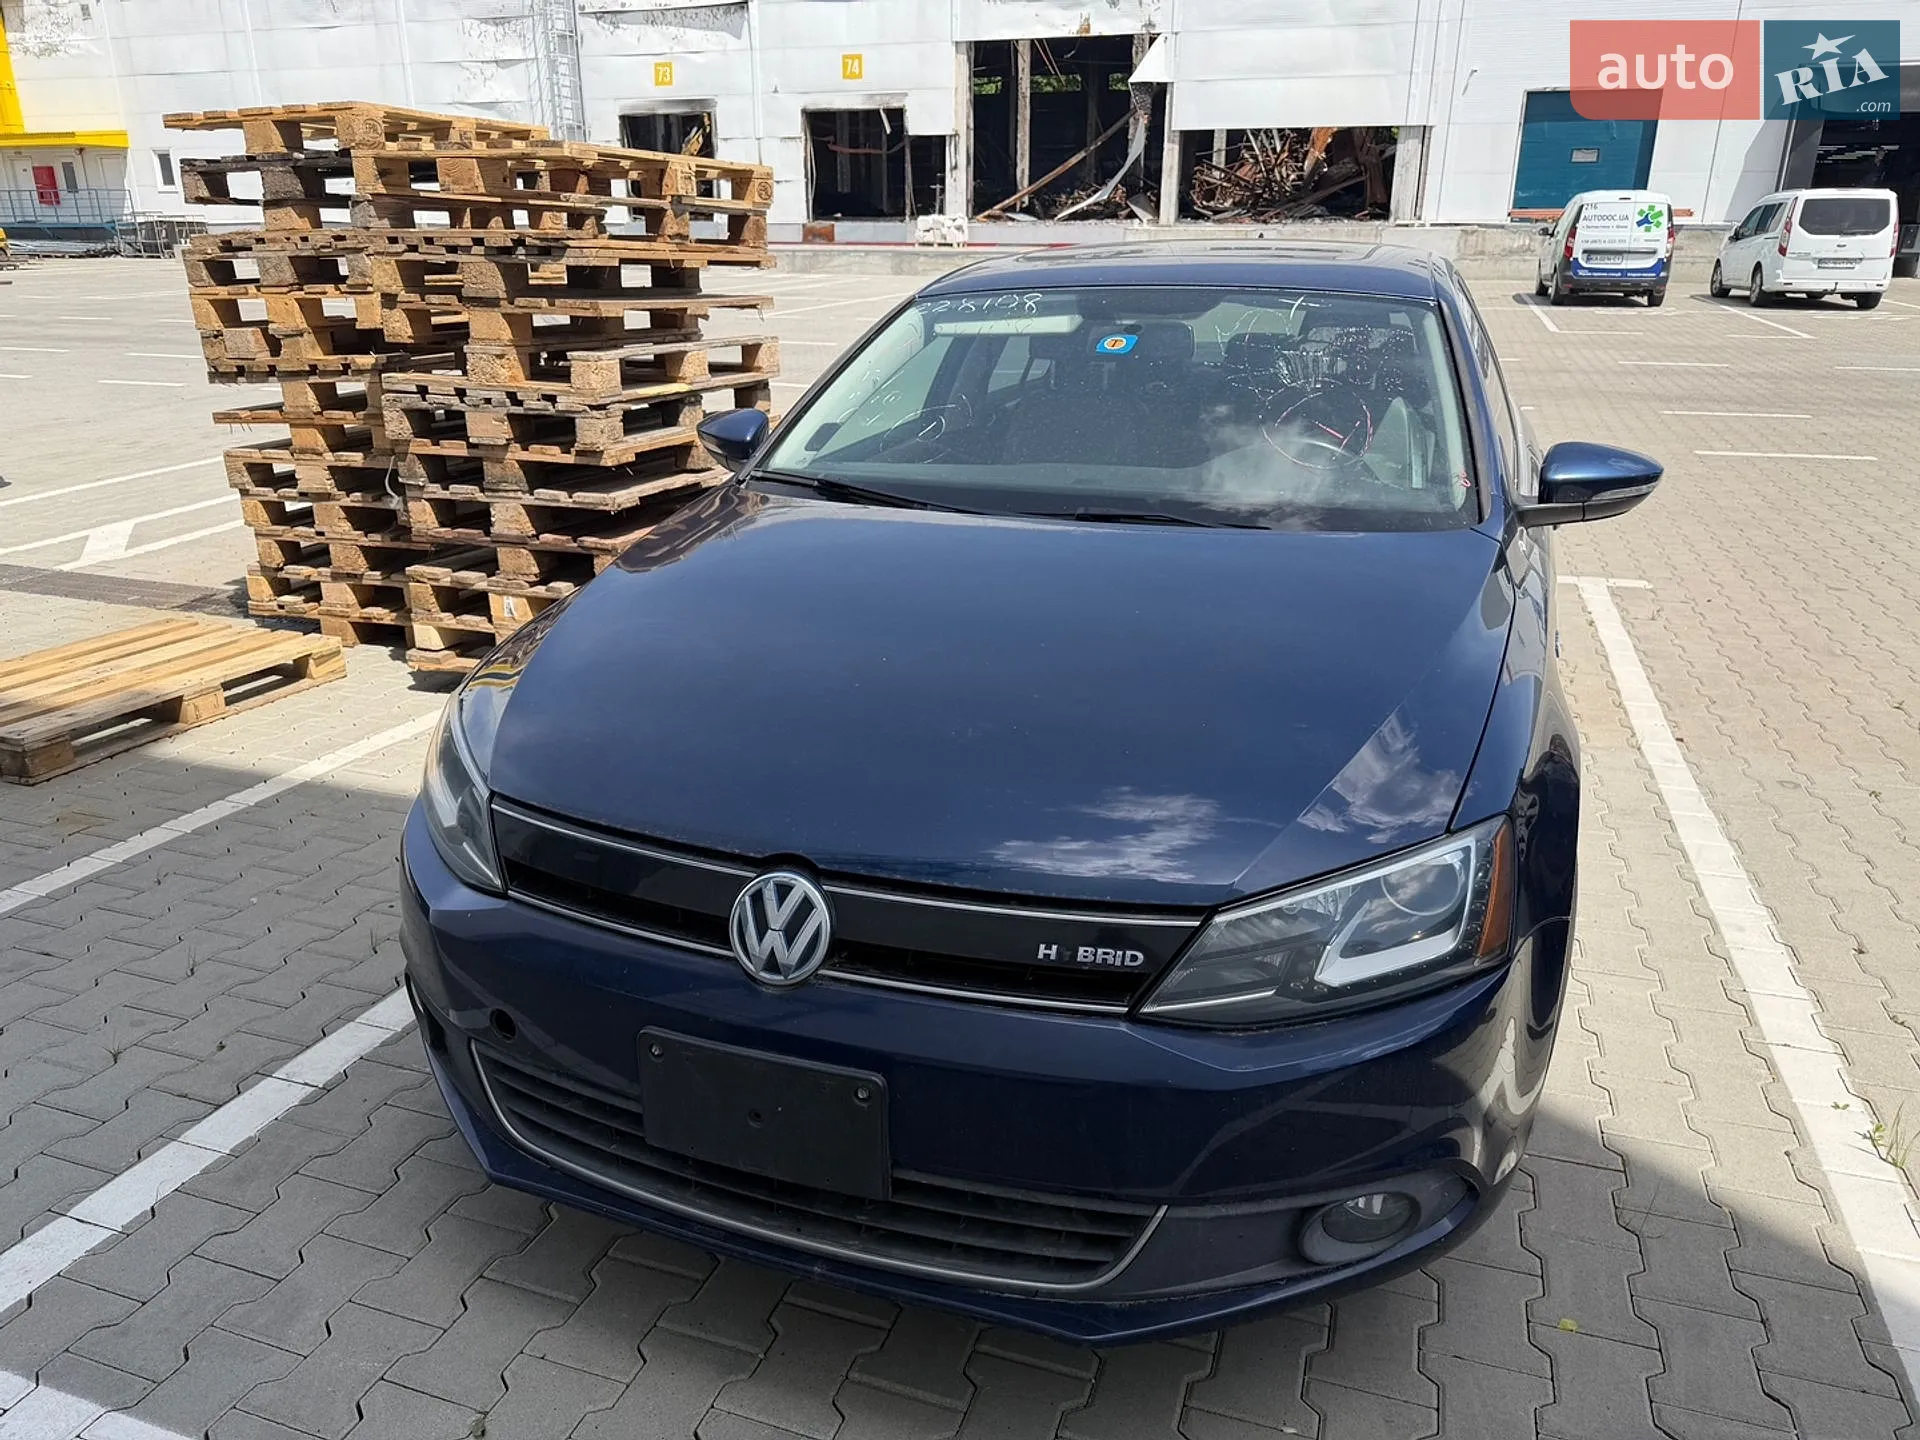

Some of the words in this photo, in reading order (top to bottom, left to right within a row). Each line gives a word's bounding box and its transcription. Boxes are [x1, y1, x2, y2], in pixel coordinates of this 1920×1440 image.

[657, 66, 671, 84] 73
[845, 59, 860, 77] 74
[1037, 943, 1144, 967] HBRID
